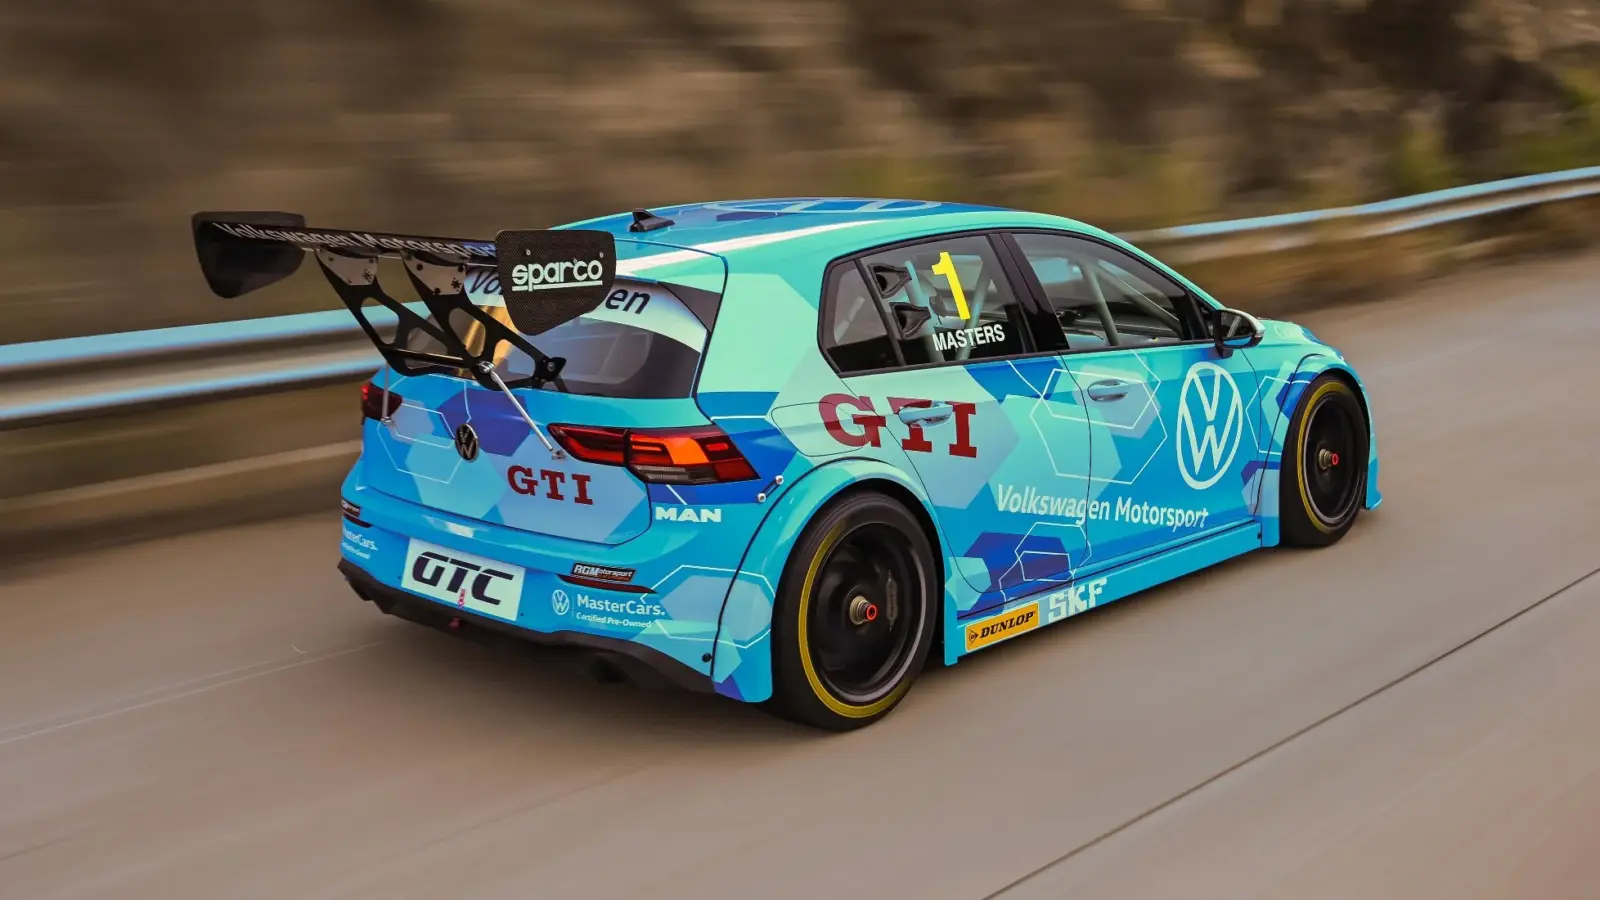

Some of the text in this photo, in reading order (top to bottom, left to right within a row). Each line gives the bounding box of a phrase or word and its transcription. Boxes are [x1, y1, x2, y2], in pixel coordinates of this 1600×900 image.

[511, 259, 603, 292] sparco
[931, 251, 971, 320] 1
[932, 324, 1006, 352] MASTERS
[818, 392, 978, 459] GTI
[507, 464, 593, 505] GTI
[655, 506, 722, 523] MAN
[998, 483, 1209, 533] Volkswagen Motorsport
[412, 551, 515, 606] GTC
[576, 593, 666, 616] MasterCars.
[1047, 576, 1108, 623] SKF
[576, 612, 652, 628] Certified Pre-Owned
[980, 611, 1035, 639] DUNLOP
